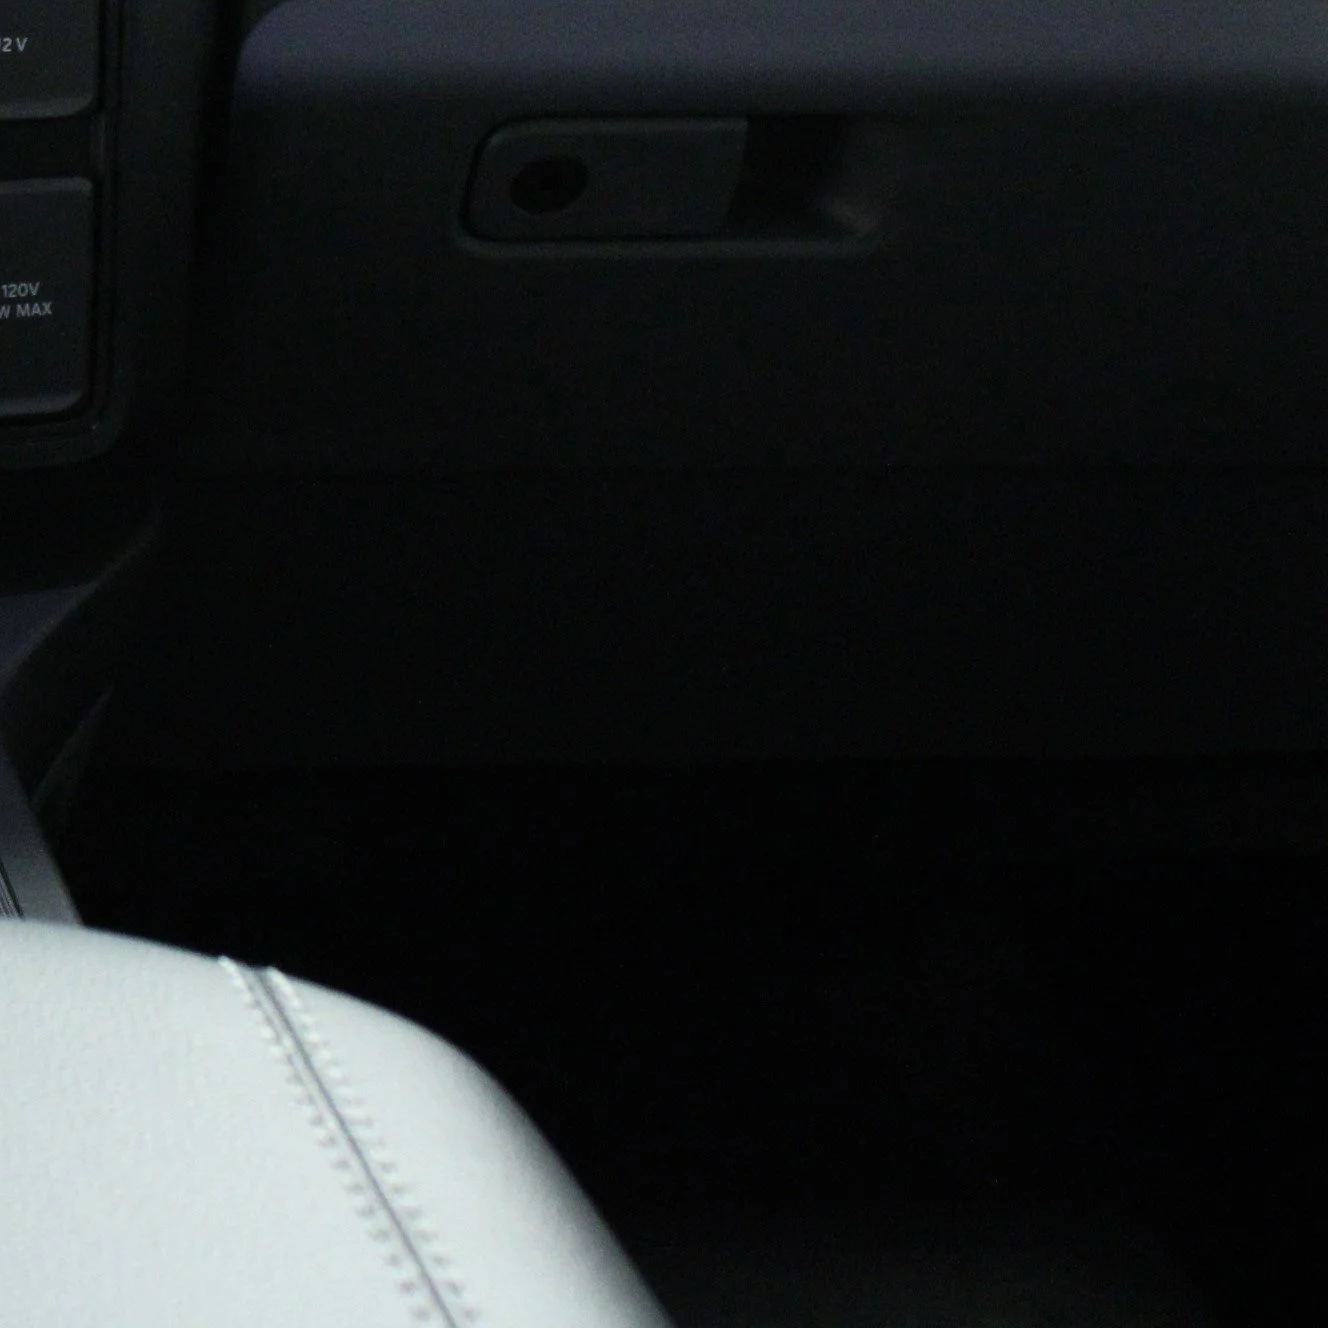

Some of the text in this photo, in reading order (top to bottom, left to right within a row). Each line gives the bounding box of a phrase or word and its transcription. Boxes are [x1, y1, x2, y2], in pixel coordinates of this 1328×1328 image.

[15, 37, 28, 52] V
[1, 282, 40, 298] 120V
[14, 302, 53, 318] MAX
